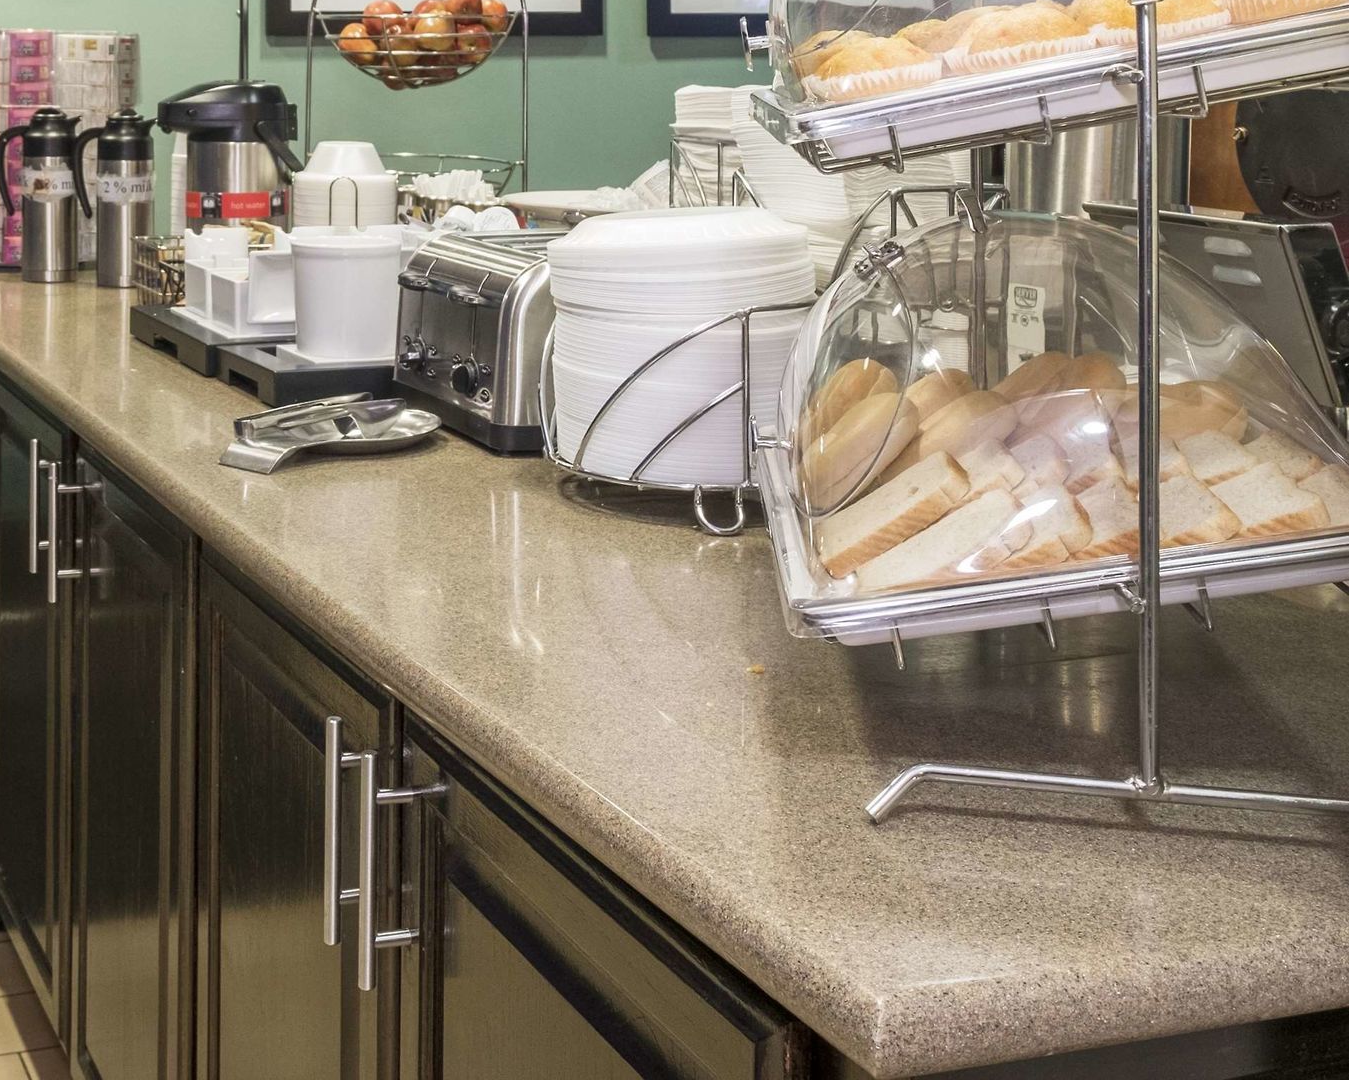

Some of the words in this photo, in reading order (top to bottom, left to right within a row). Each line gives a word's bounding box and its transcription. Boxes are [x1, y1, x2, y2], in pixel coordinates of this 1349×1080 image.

[104, 181, 110, 193] 2
[113, 180, 127, 193] %
[230, 201, 244, 209] hot
[245, 201, 266, 209] water
